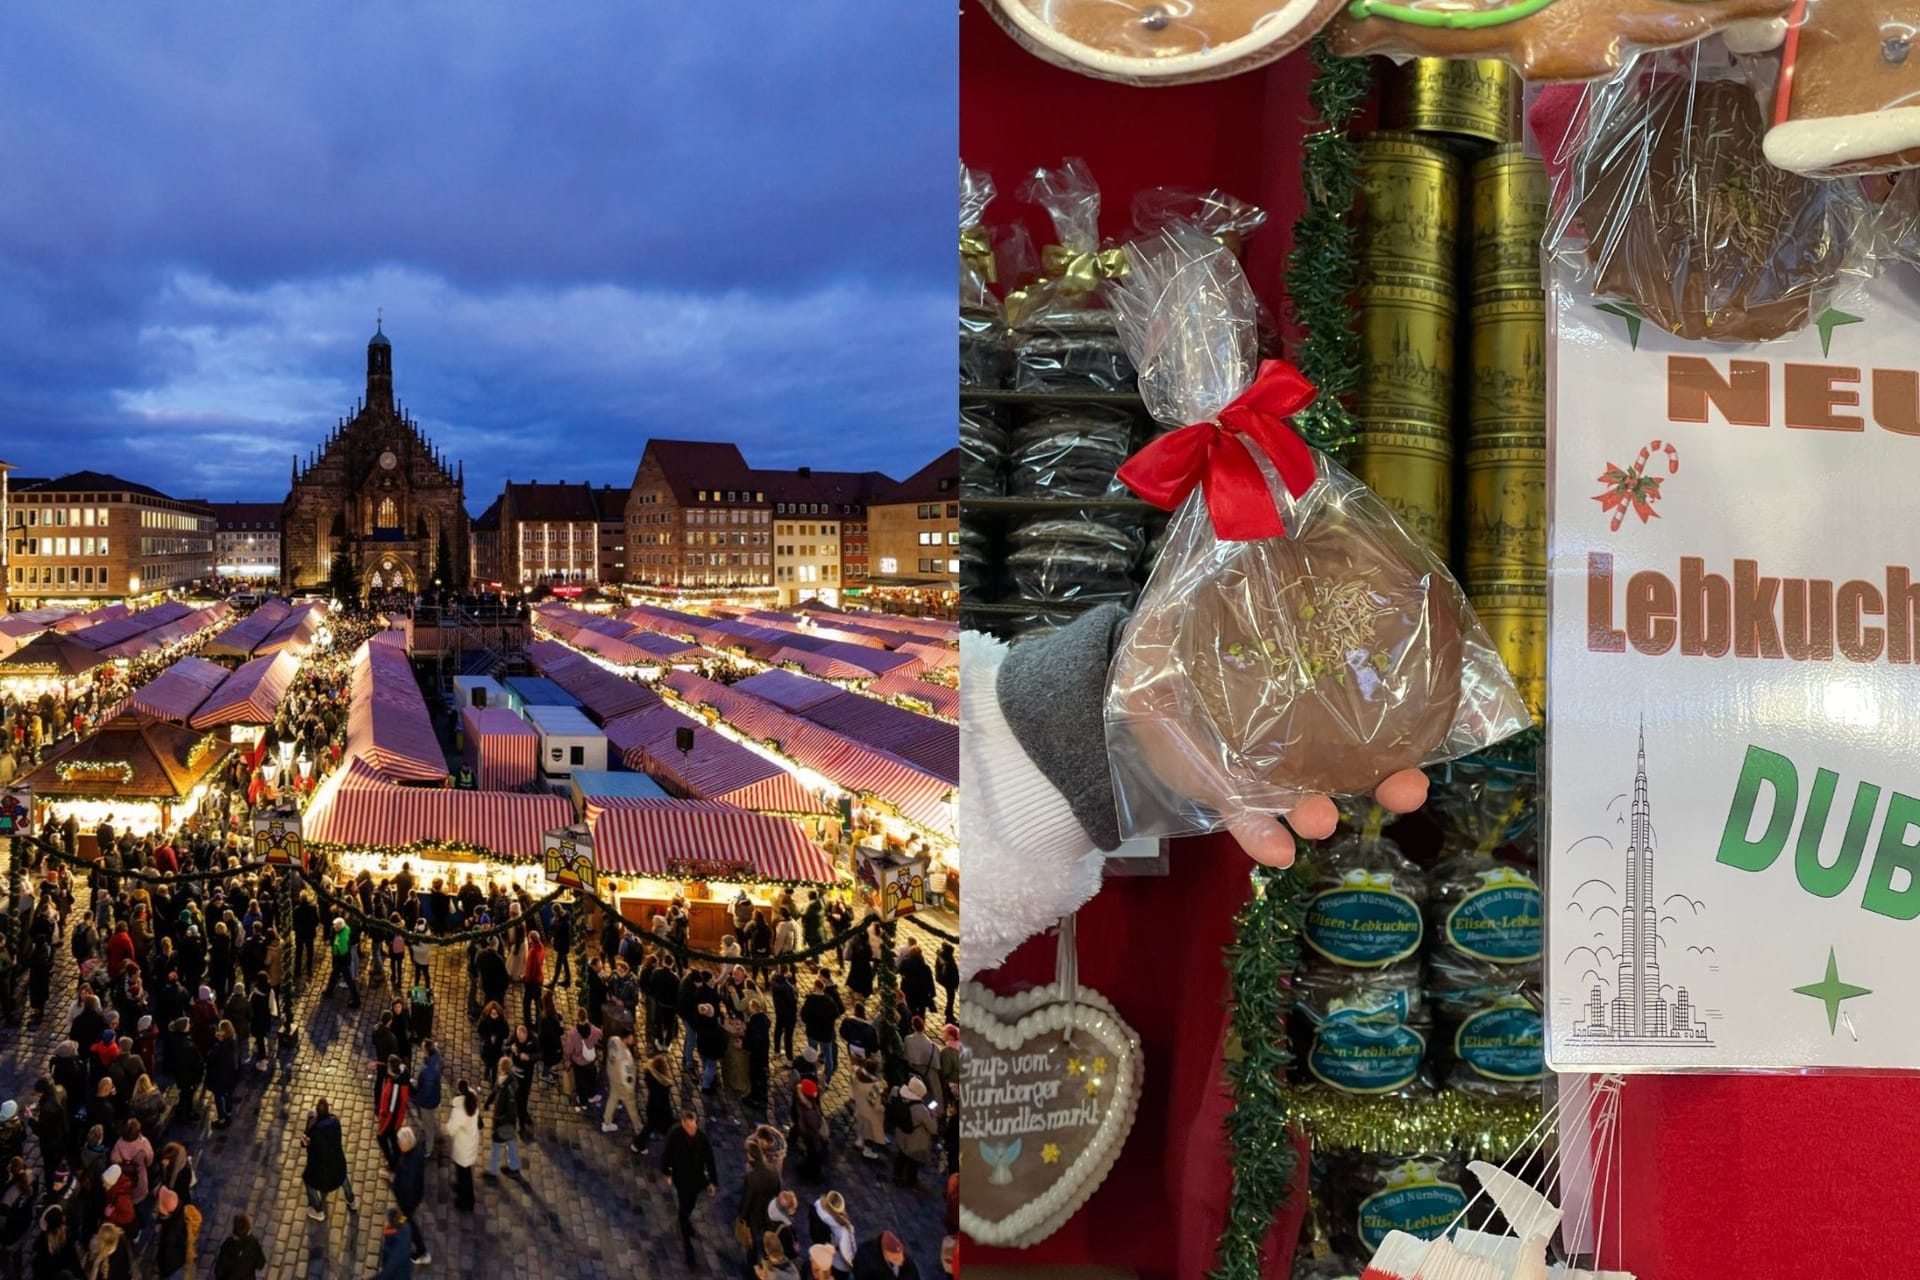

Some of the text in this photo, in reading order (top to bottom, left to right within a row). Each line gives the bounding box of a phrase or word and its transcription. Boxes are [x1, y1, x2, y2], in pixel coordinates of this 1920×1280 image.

[1587, 551, 1920, 664] Lebkuch
[1716, 744, 1920, 921] DUB
[1317, 894, 1412, 918] Original Nürnberger
[1309, 911, 1418, 933] Elisen-Lebkuchen
[1012, 1054, 1052, 1076] vom
